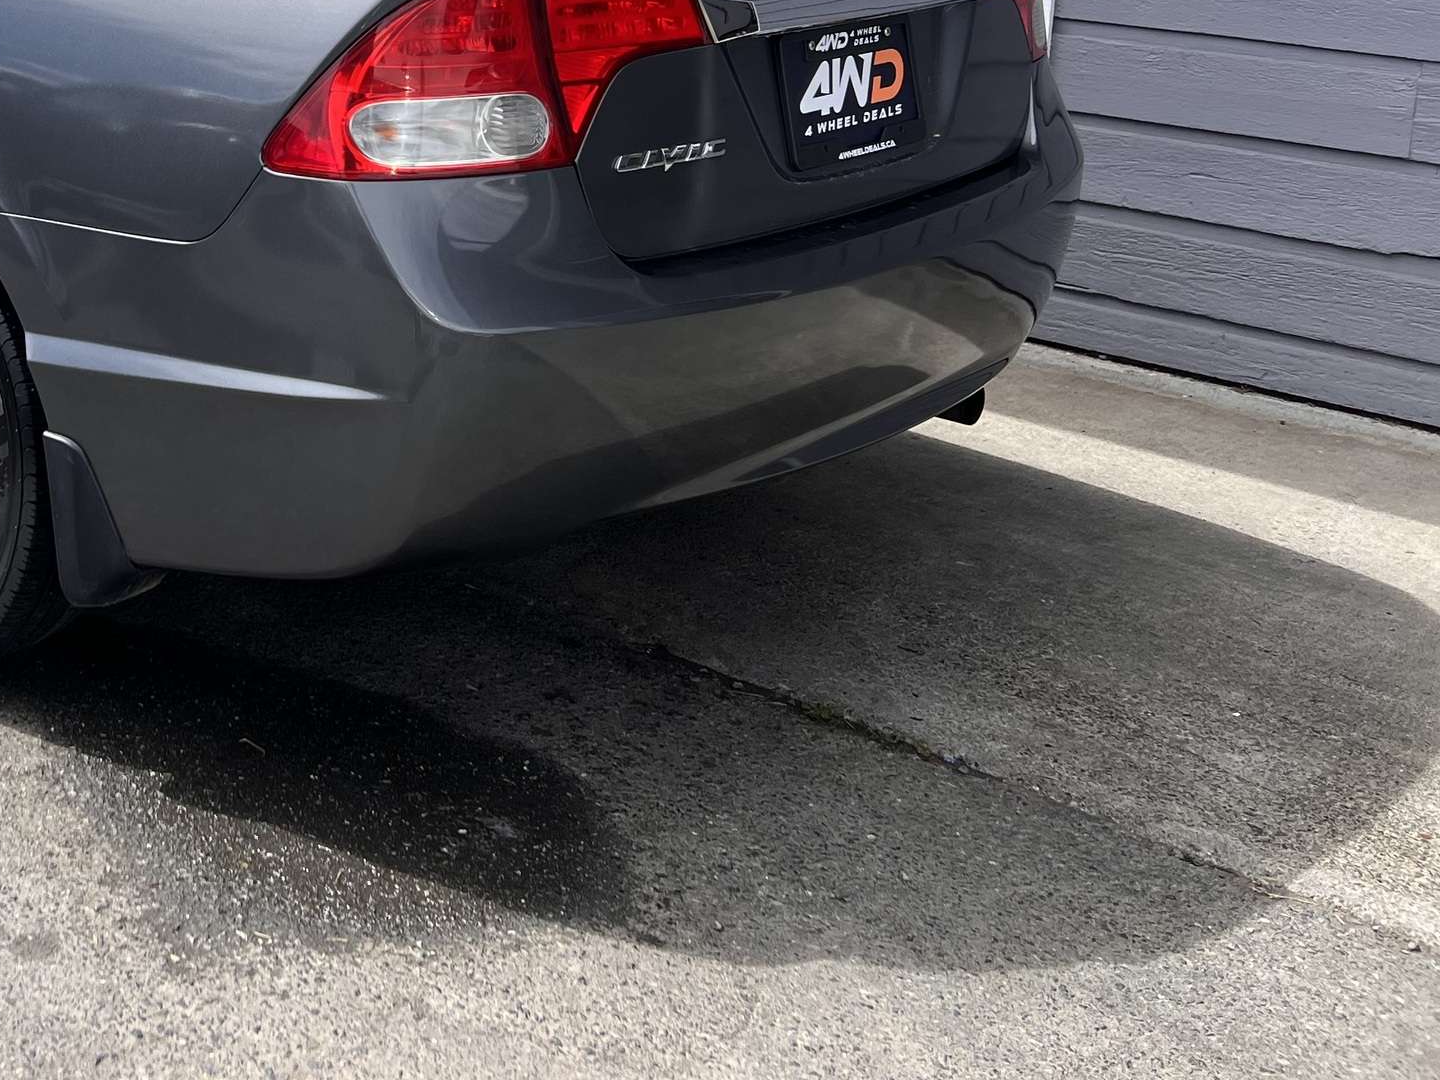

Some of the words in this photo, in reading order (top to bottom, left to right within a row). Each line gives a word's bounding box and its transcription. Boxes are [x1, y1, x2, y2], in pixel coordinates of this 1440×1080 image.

[854, 34, 879, 46] DEALS
[800, 48, 904, 116] 4WD
[804, 125, 813, 136] 4
[817, 115, 858, 134] WHEEL
[863, 104, 902, 123] DEALS
[612, 139, 726, 172] CIVIC
